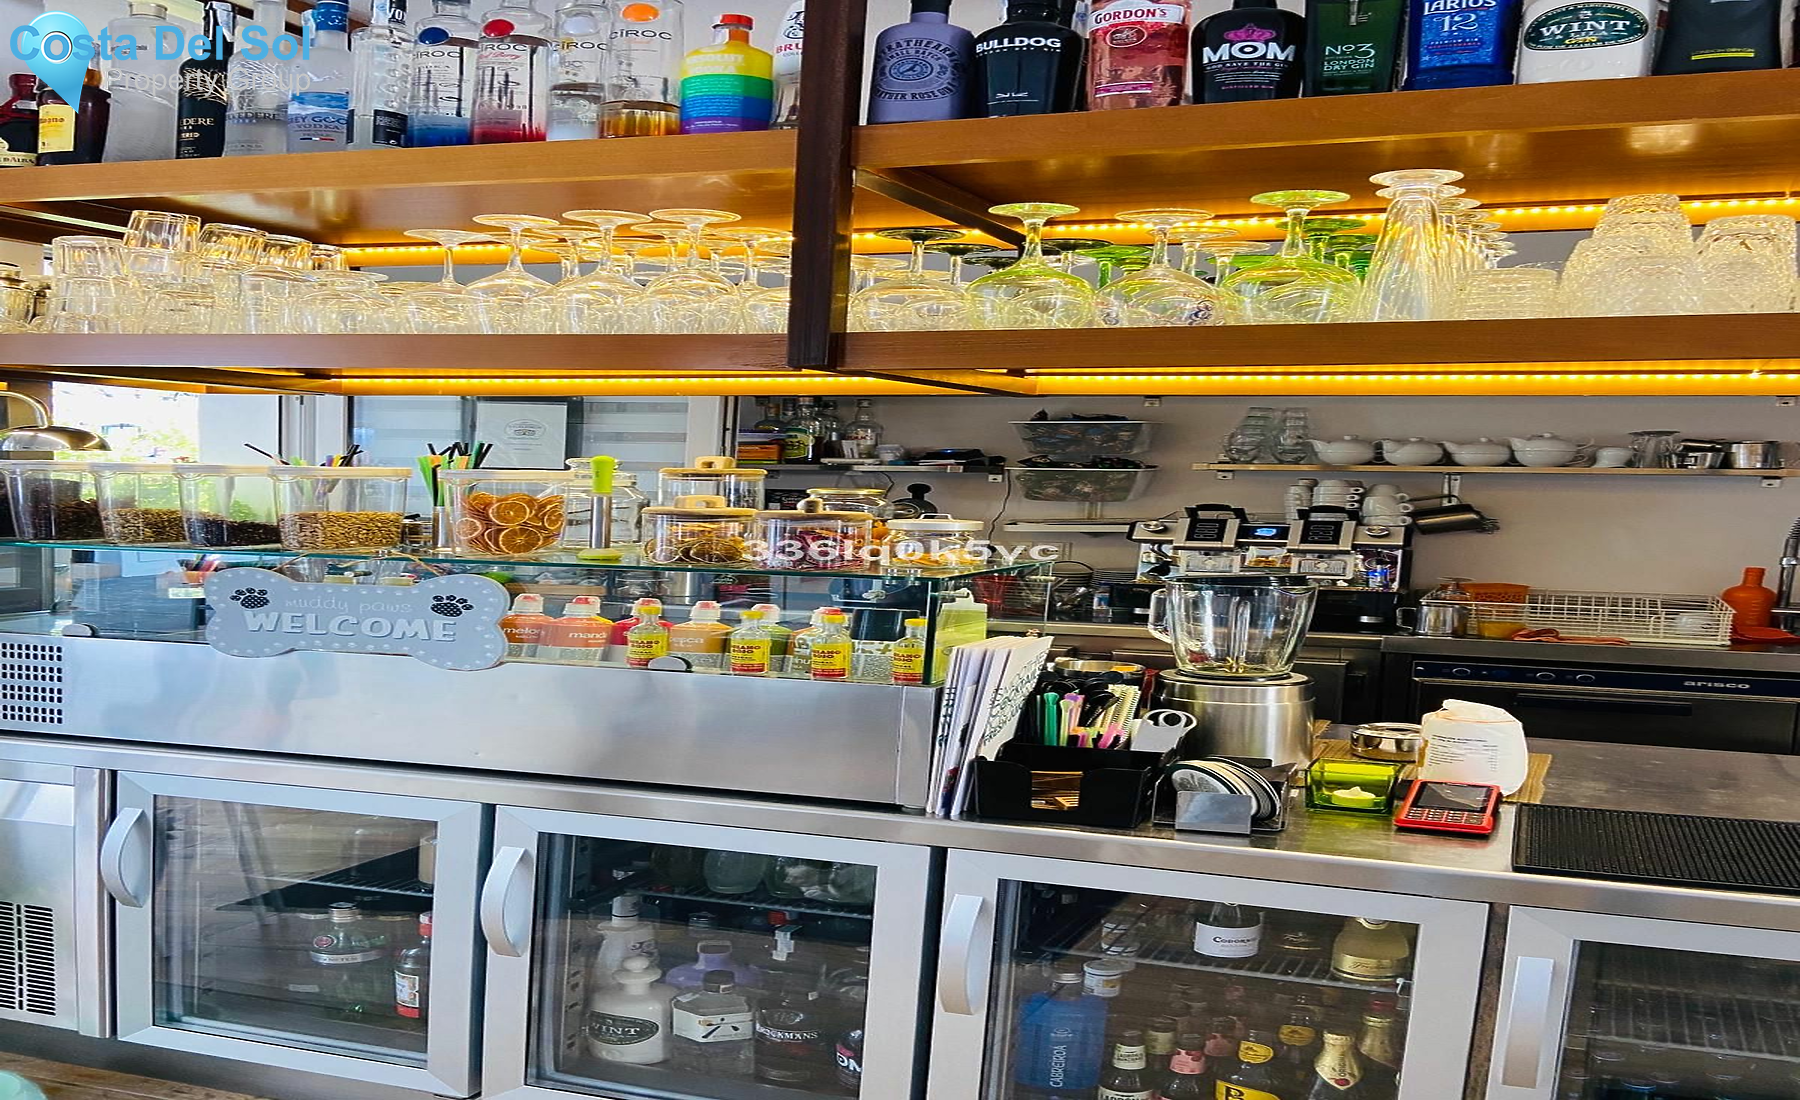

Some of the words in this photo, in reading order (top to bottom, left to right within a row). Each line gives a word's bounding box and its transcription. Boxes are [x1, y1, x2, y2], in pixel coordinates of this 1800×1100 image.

[1094, 7, 1167, 25] GORDON'S
[1433, 13, 1479, 32] 12
[1540, 20, 1631, 37] WINT
[976, 37, 1061, 53] BULLDOG
[1202, 41, 1296, 64] MOM
[359, 602, 412, 615] paws
[243, 611, 457, 642] WELCOME
[1049, 1045, 1067, 1088] CABREIROA
